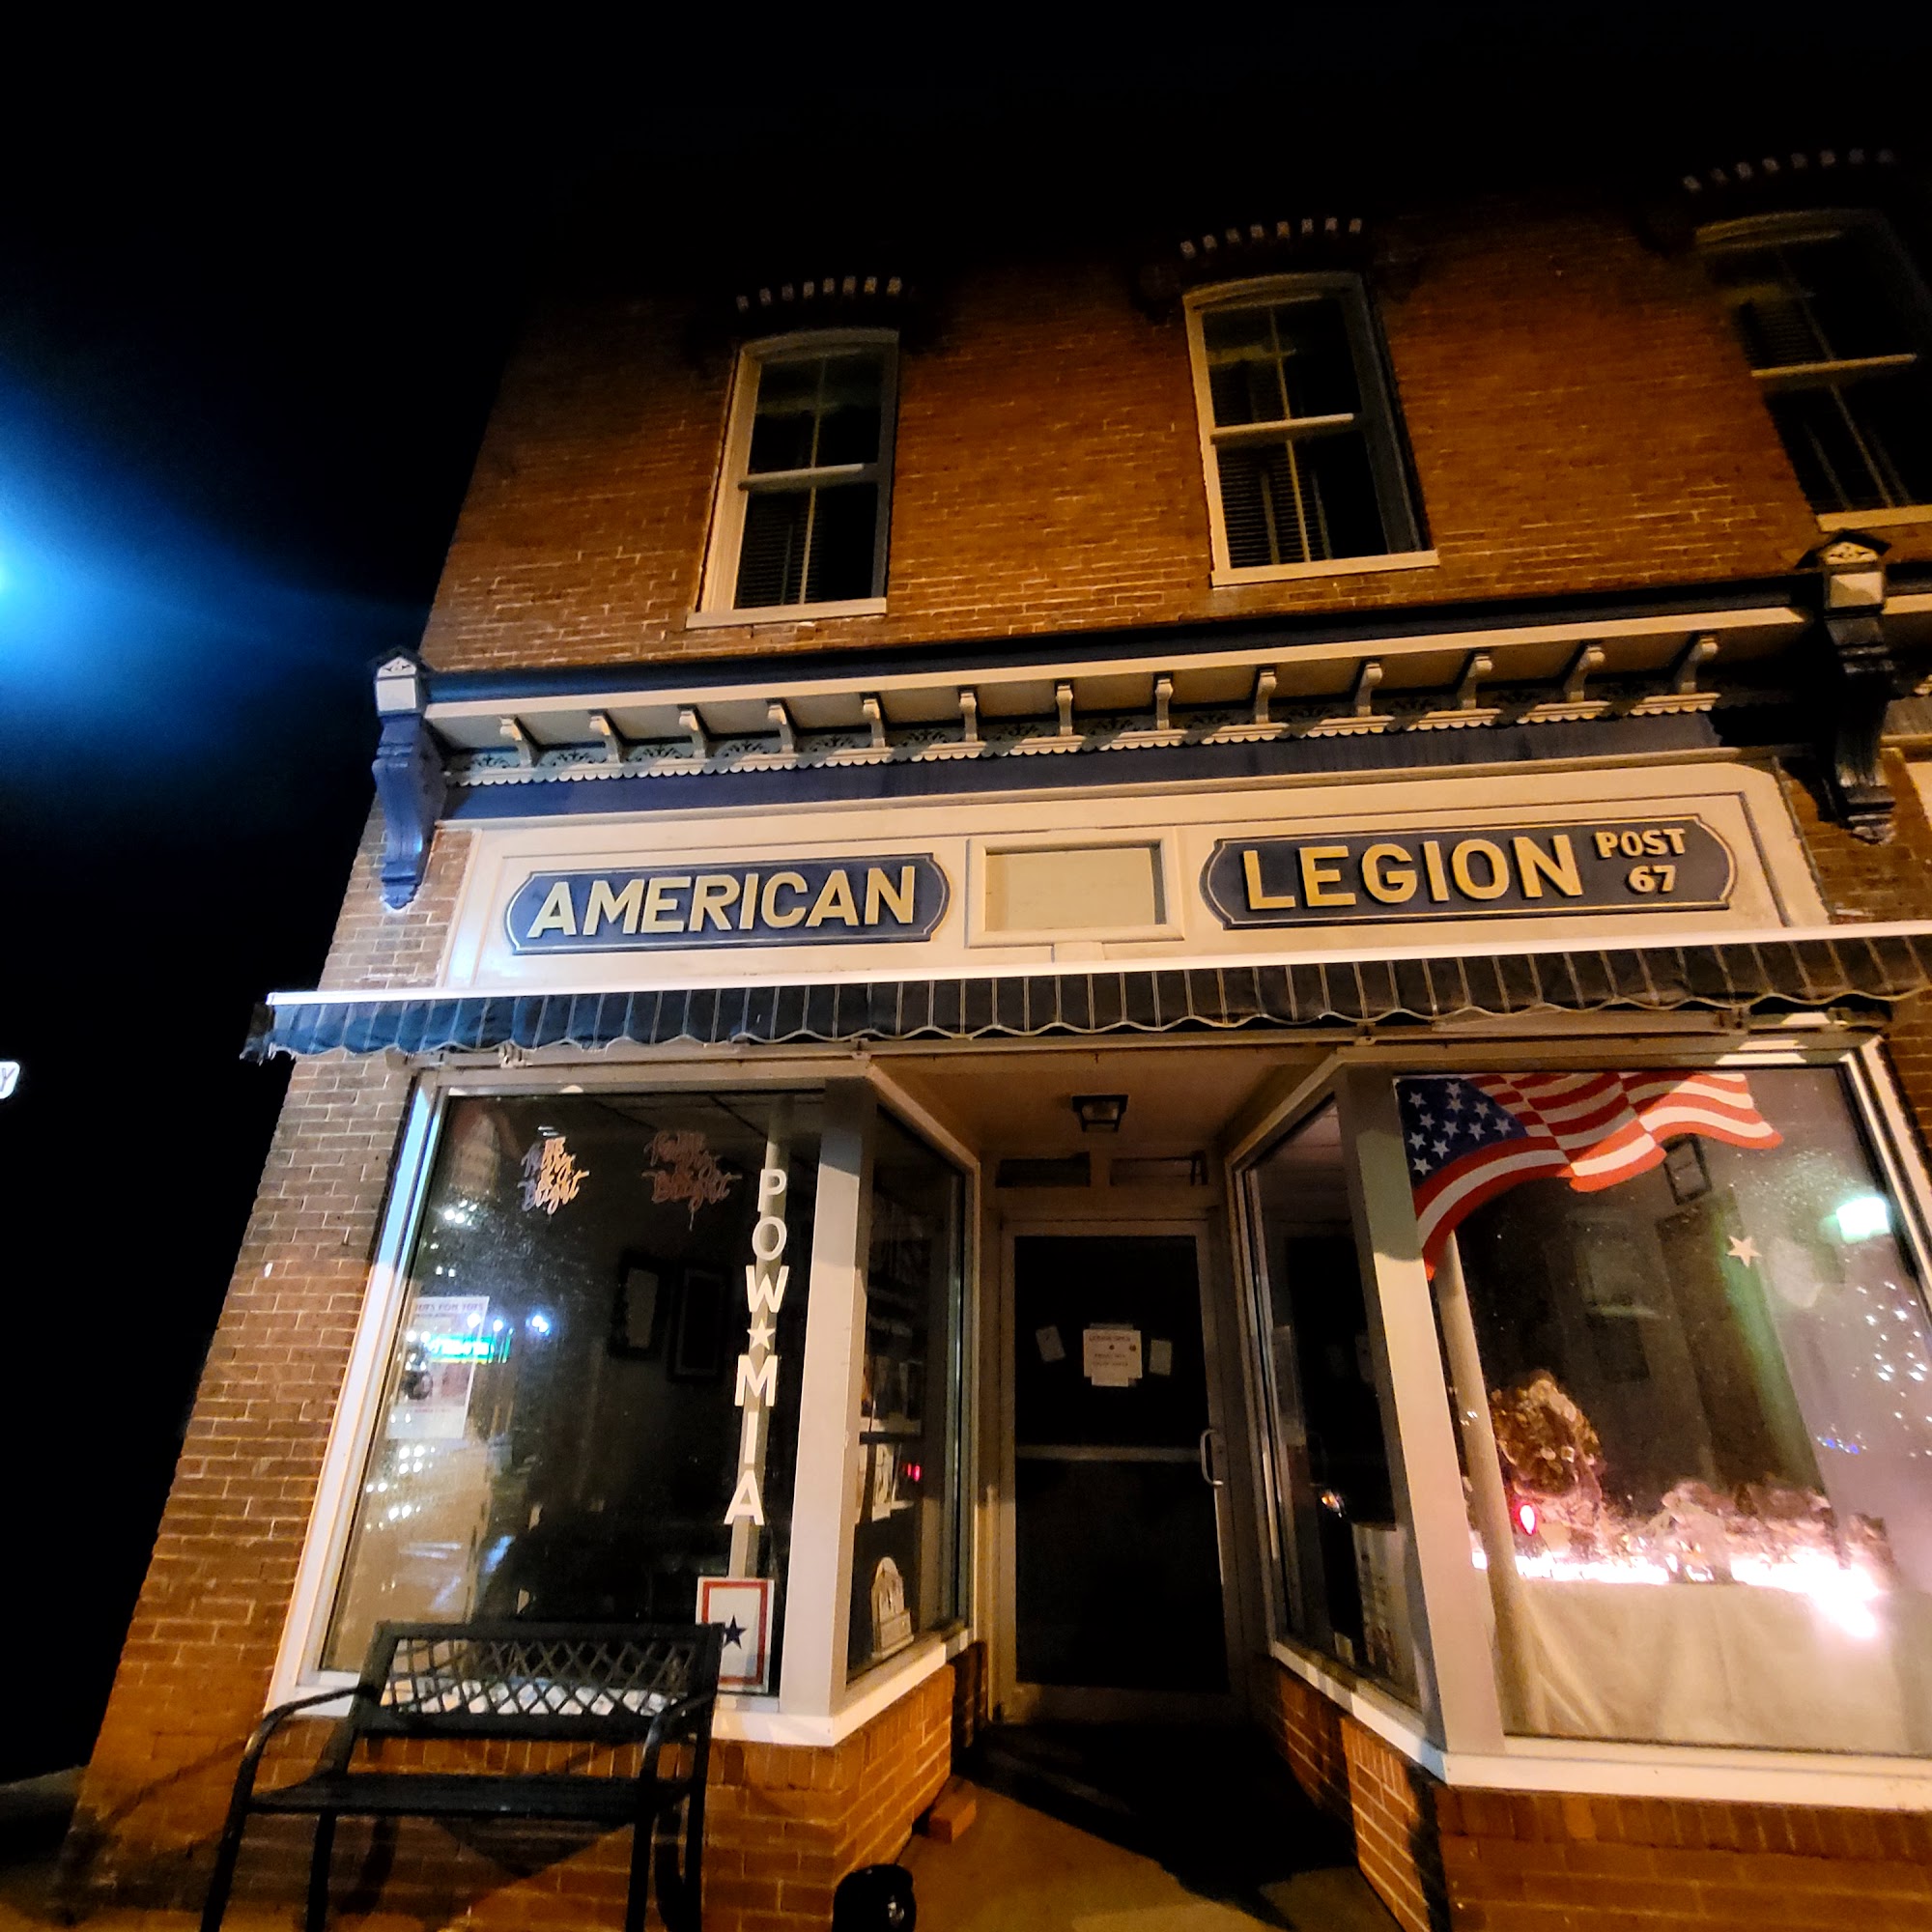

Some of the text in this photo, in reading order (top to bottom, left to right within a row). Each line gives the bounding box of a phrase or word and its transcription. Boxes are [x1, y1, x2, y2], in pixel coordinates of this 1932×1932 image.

[1242, 834, 1582, 910] LEGION
[1595, 828, 1686, 859] POST
[1628, 865, 1676, 893] 67
[526, 866, 915, 938] AMERICAN
[746, 1169, 789, 1313] POW
[724, 1354, 779, 1525] MIA
